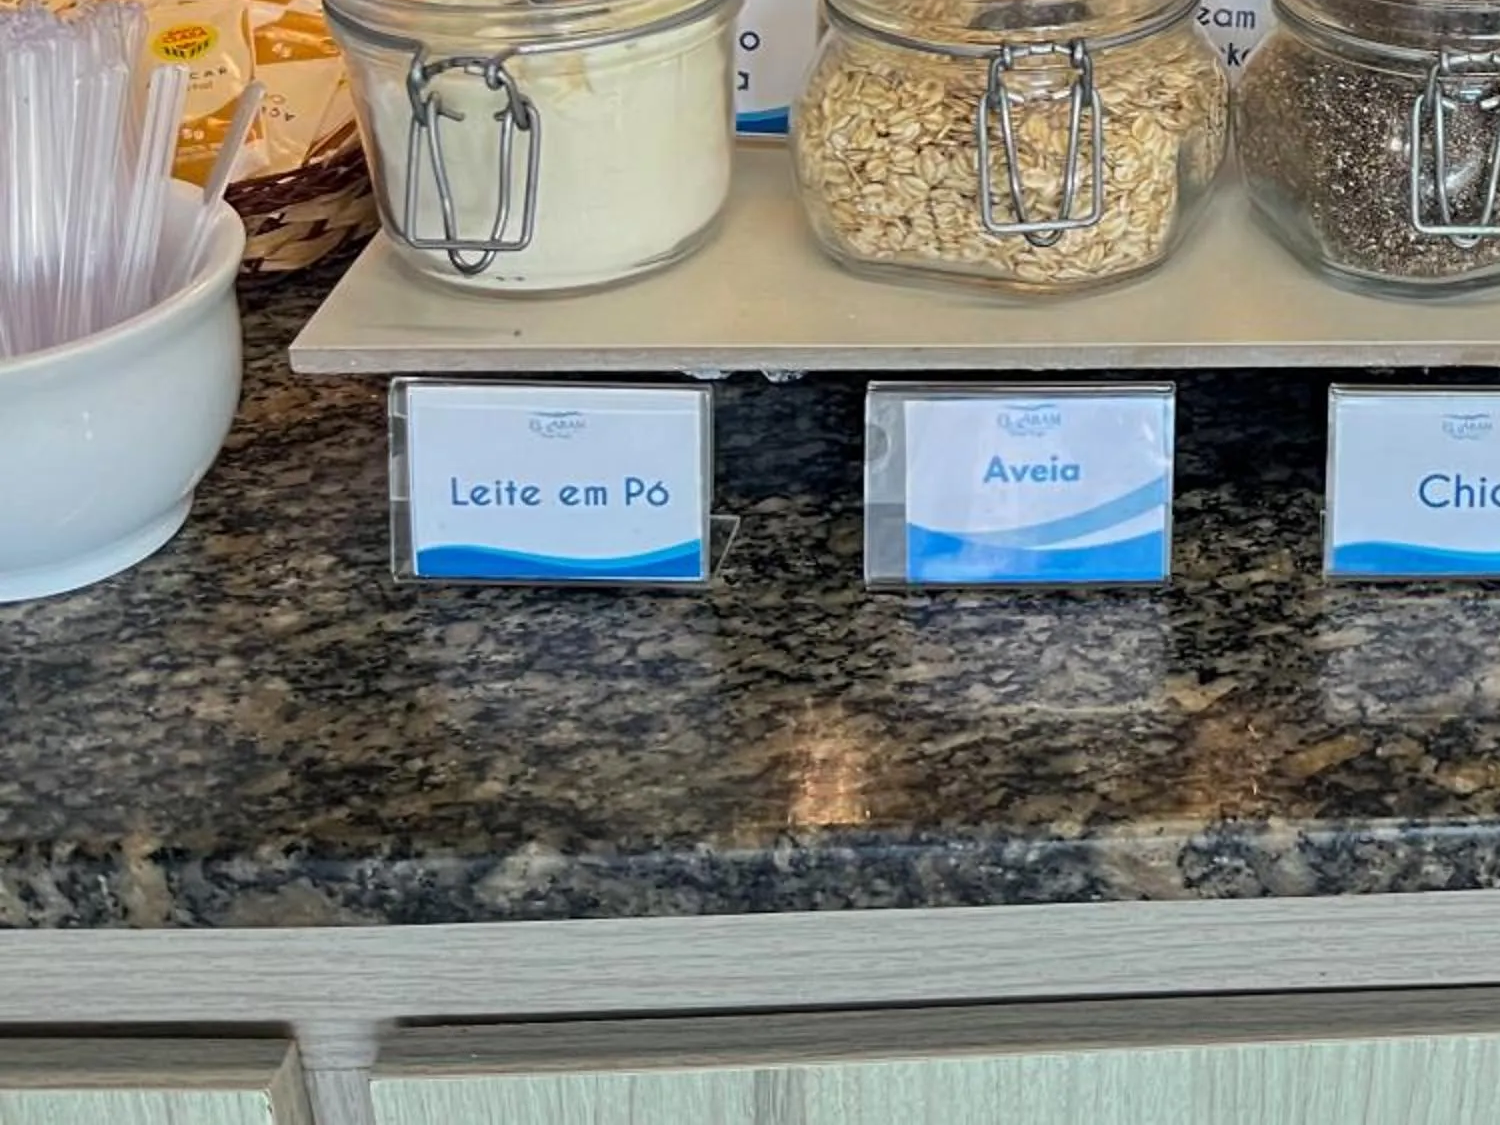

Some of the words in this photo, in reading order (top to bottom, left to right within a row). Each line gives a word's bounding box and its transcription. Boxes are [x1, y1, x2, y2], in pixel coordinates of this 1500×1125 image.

[983, 455, 1081, 484] Aveia
[450, 477, 542, 507] Leite
[559, 484, 608, 506] em
[625, 477, 670, 507] Pó
